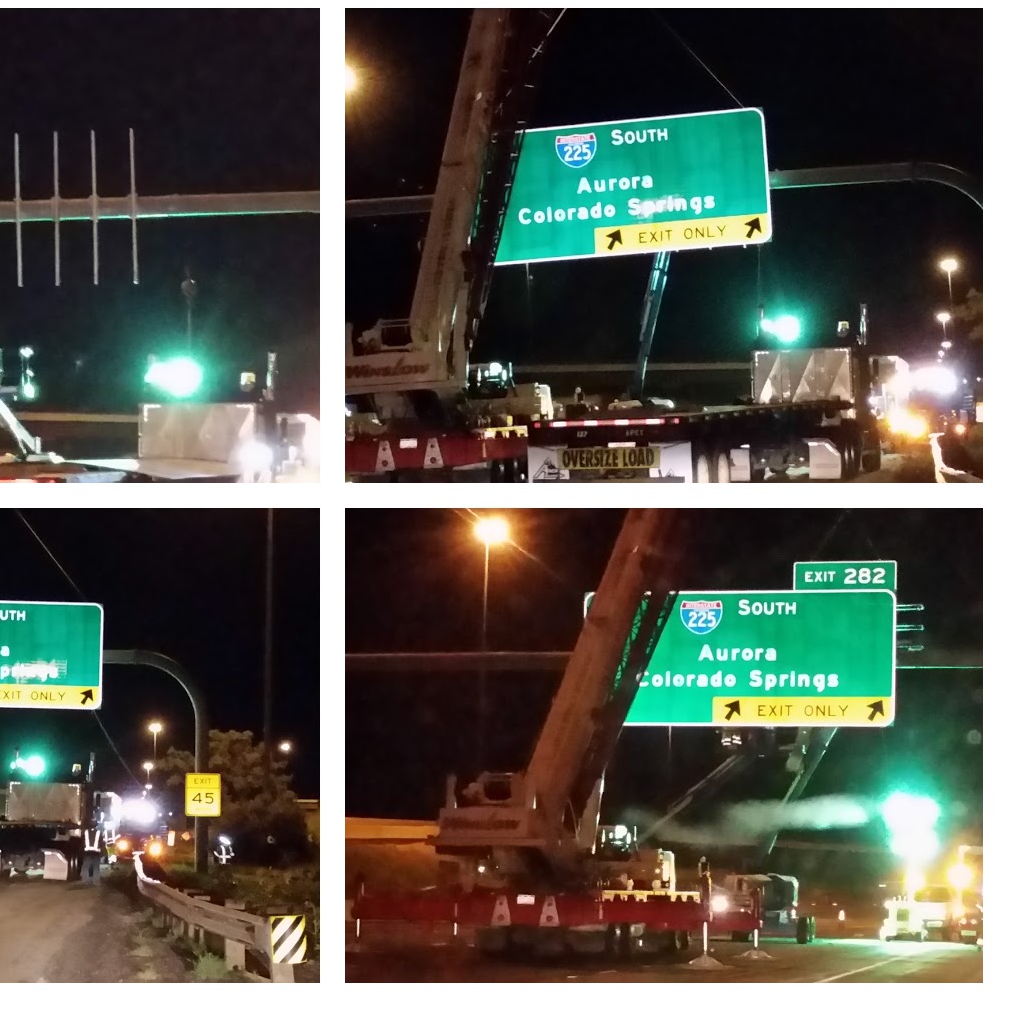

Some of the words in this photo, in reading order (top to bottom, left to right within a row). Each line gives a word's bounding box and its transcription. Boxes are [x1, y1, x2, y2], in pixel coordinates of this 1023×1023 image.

[563, 144, 592, 162] 225
[577, 175, 653, 194] Aurora
[518, 202, 616, 225] Colorado
[628, 195, 716, 218] Springs
[638, 229, 671, 244] EXIT
[684, 225, 727, 241] ONLY
[562, 449, 619, 468] OVERSIZE
[623, 448, 655, 467] LOAD
[804, 571, 836, 583] EXIT
[843, 568, 886, 585] 282
[688, 611, 717, 628] 225
[698, 644, 777, 662] Aurora
[636, 670, 737, 688] Colorado
[749, 670, 839, 691] Springs
[31, 691, 66, 701] ONLY
[757, 705, 793, 717] EXIT
[804, 705, 849, 717] ONLY
[192, 792, 215, 805] 45
